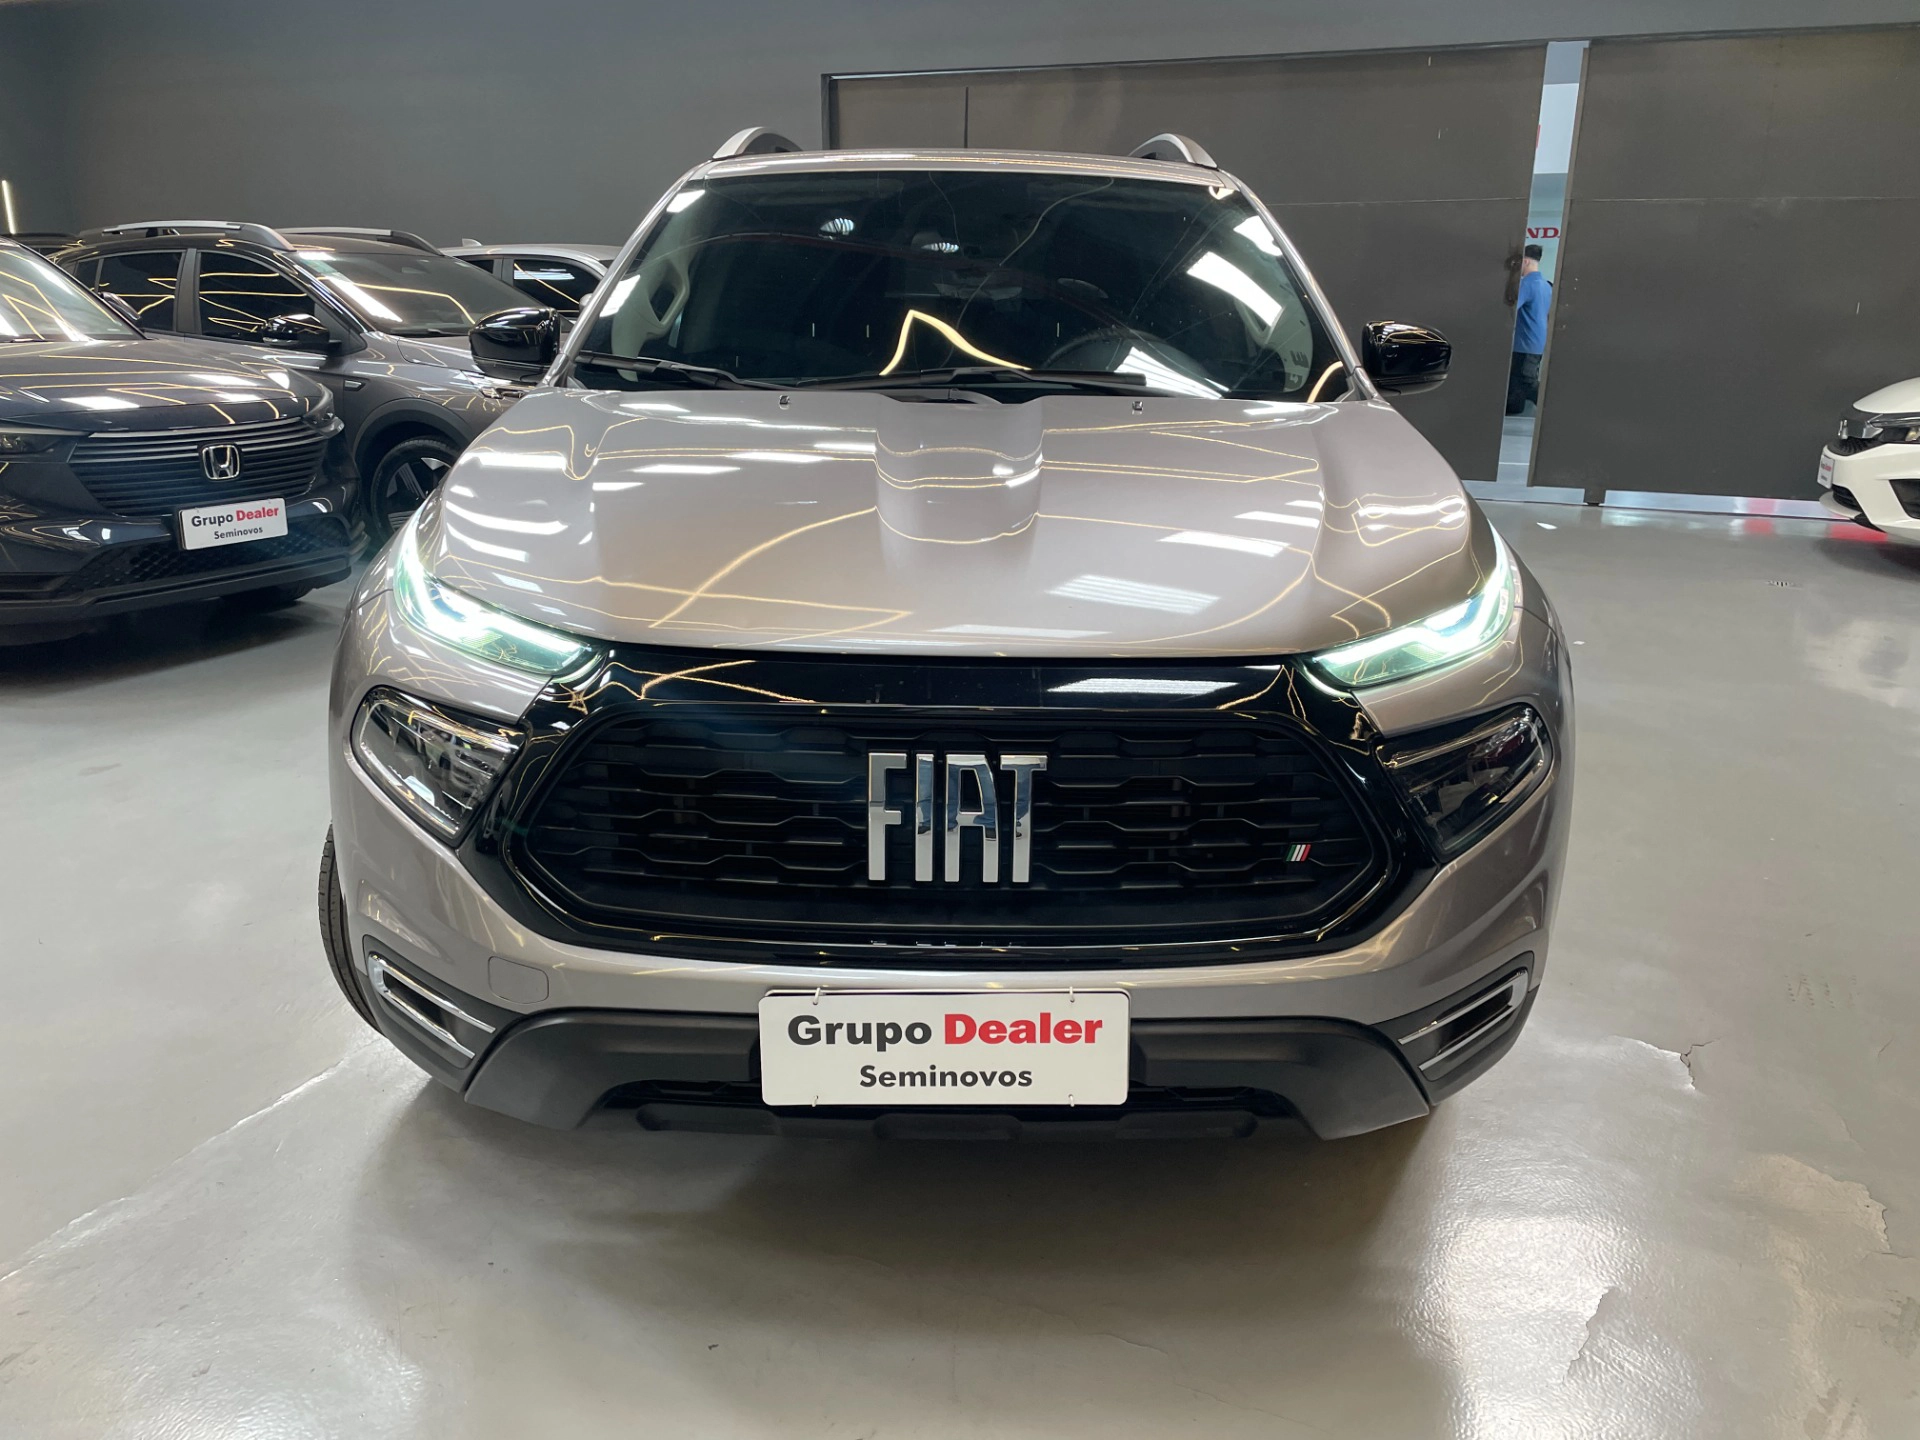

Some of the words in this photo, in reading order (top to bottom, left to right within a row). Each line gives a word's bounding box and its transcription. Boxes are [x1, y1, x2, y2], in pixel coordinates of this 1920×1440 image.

[1526, 227, 1560, 239] ND
[191, 513, 234, 527] Grupo
[236, 507, 279, 522] Dealer
[214, 526, 263, 540] Seminovos
[868, 752, 1048, 882] FIAT
[787, 1014, 932, 1052] Grupo
[944, 1012, 1103, 1045] Dealer
[859, 1064, 1033, 1088] Seminovos
